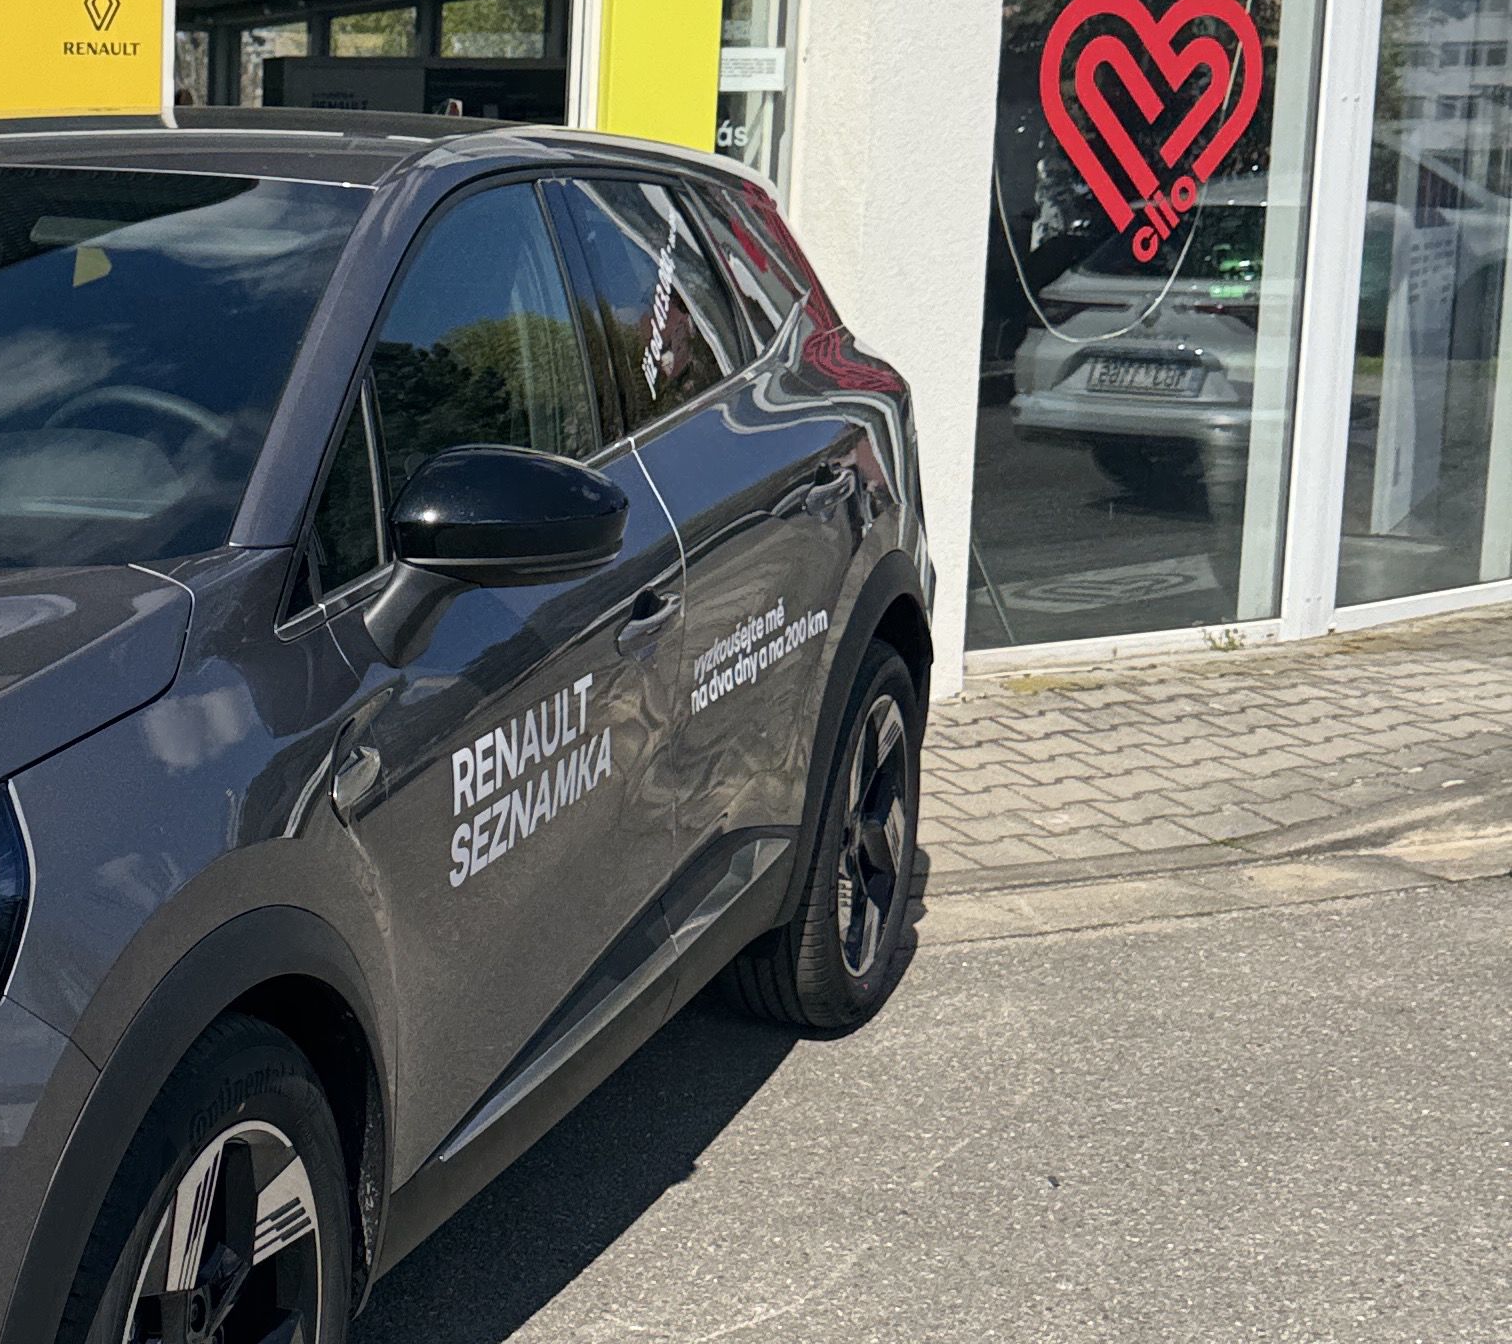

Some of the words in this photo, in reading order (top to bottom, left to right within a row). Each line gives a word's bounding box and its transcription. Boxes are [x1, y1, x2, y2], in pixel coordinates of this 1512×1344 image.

[63, 41, 141, 56] RENAULT
[1132, 175, 1197, 262] clio
[690, 684, 708, 715] na
[708, 668, 734, 702] dva
[734, 652, 759, 684] dny
[759, 646, 767, 669] a
[769, 635, 784, 664] na
[785, 616, 806, 654] 200
[807, 609, 829, 639] km
[693, 616, 764, 684] vyzkoušejte
[765, 596, 785, 635] mě
[451, 672, 594, 817] RENAULT
[449, 726, 612, 888] SEZNAMKA
